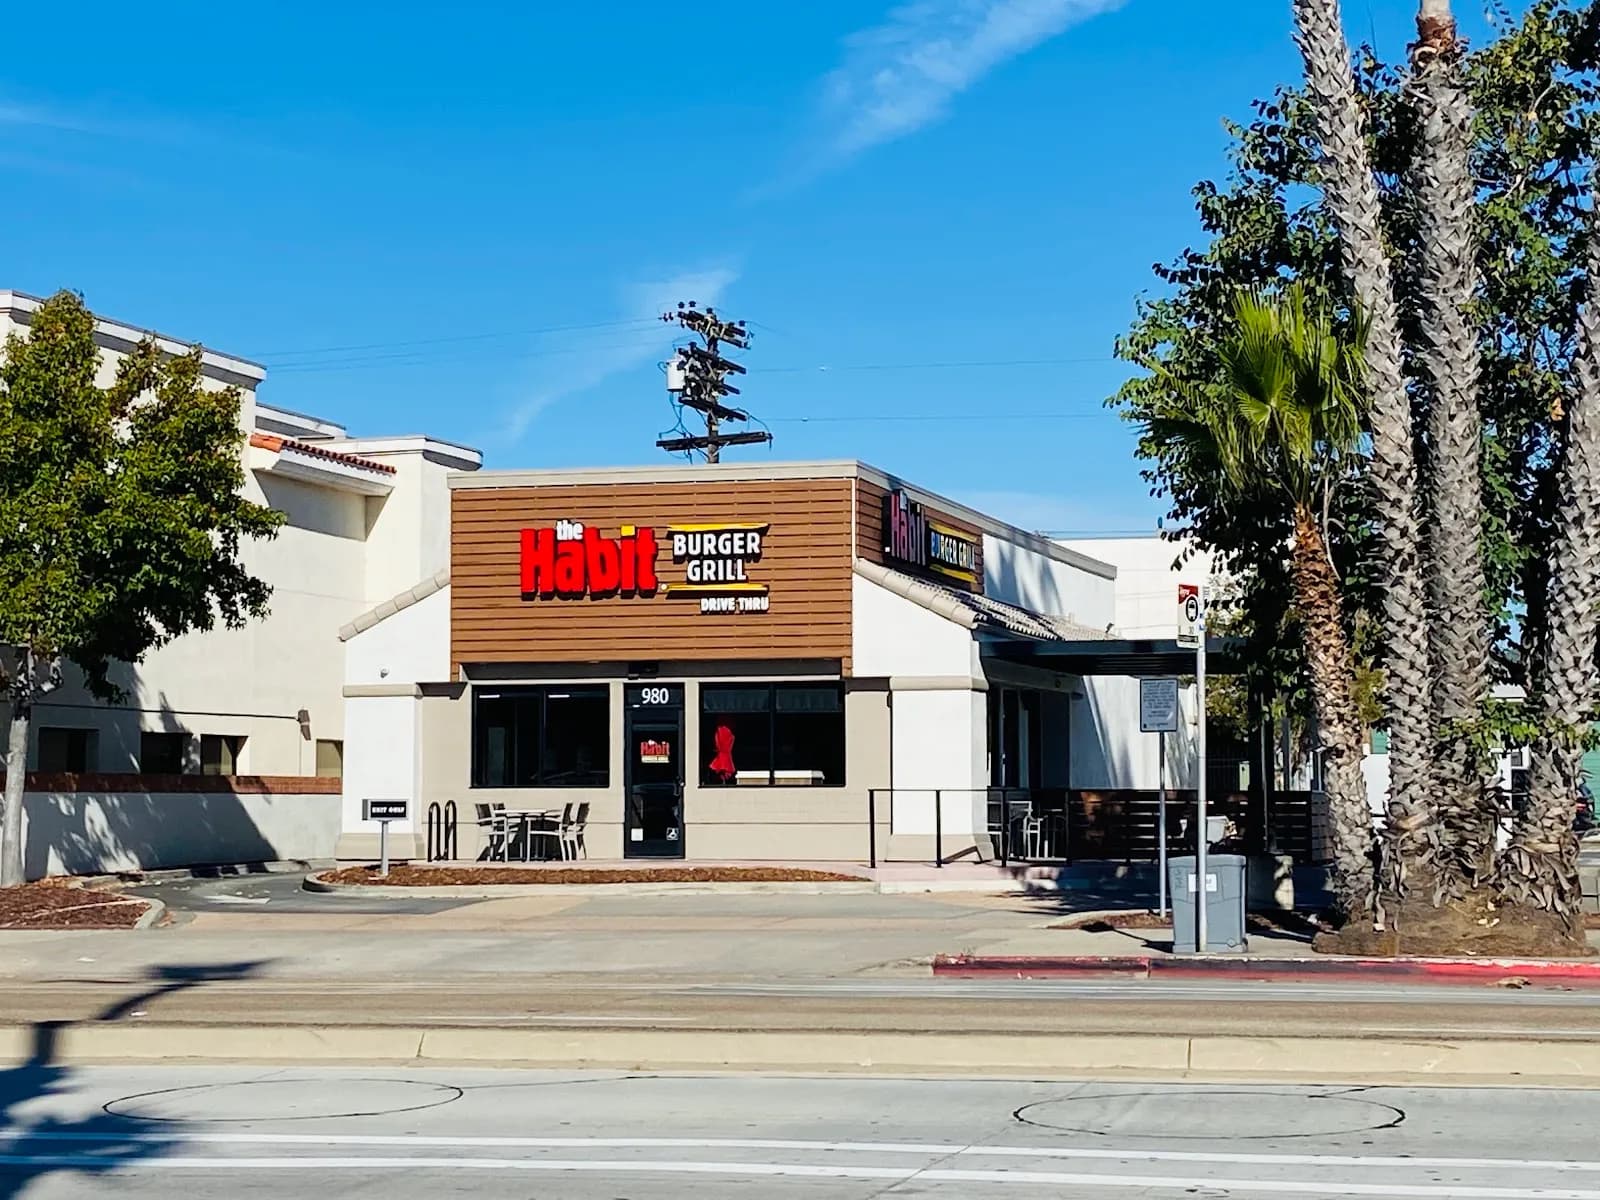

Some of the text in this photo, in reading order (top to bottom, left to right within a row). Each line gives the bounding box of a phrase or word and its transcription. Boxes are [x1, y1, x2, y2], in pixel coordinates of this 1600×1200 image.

[556, 519, 584, 541] the
[673, 533, 760, 556] BURGER
[520, 524, 657, 595] Habit
[687, 559, 747, 581] GRILL
[701, 597, 769, 611] DRIVE THRU
[641, 688, 669, 704] 980
